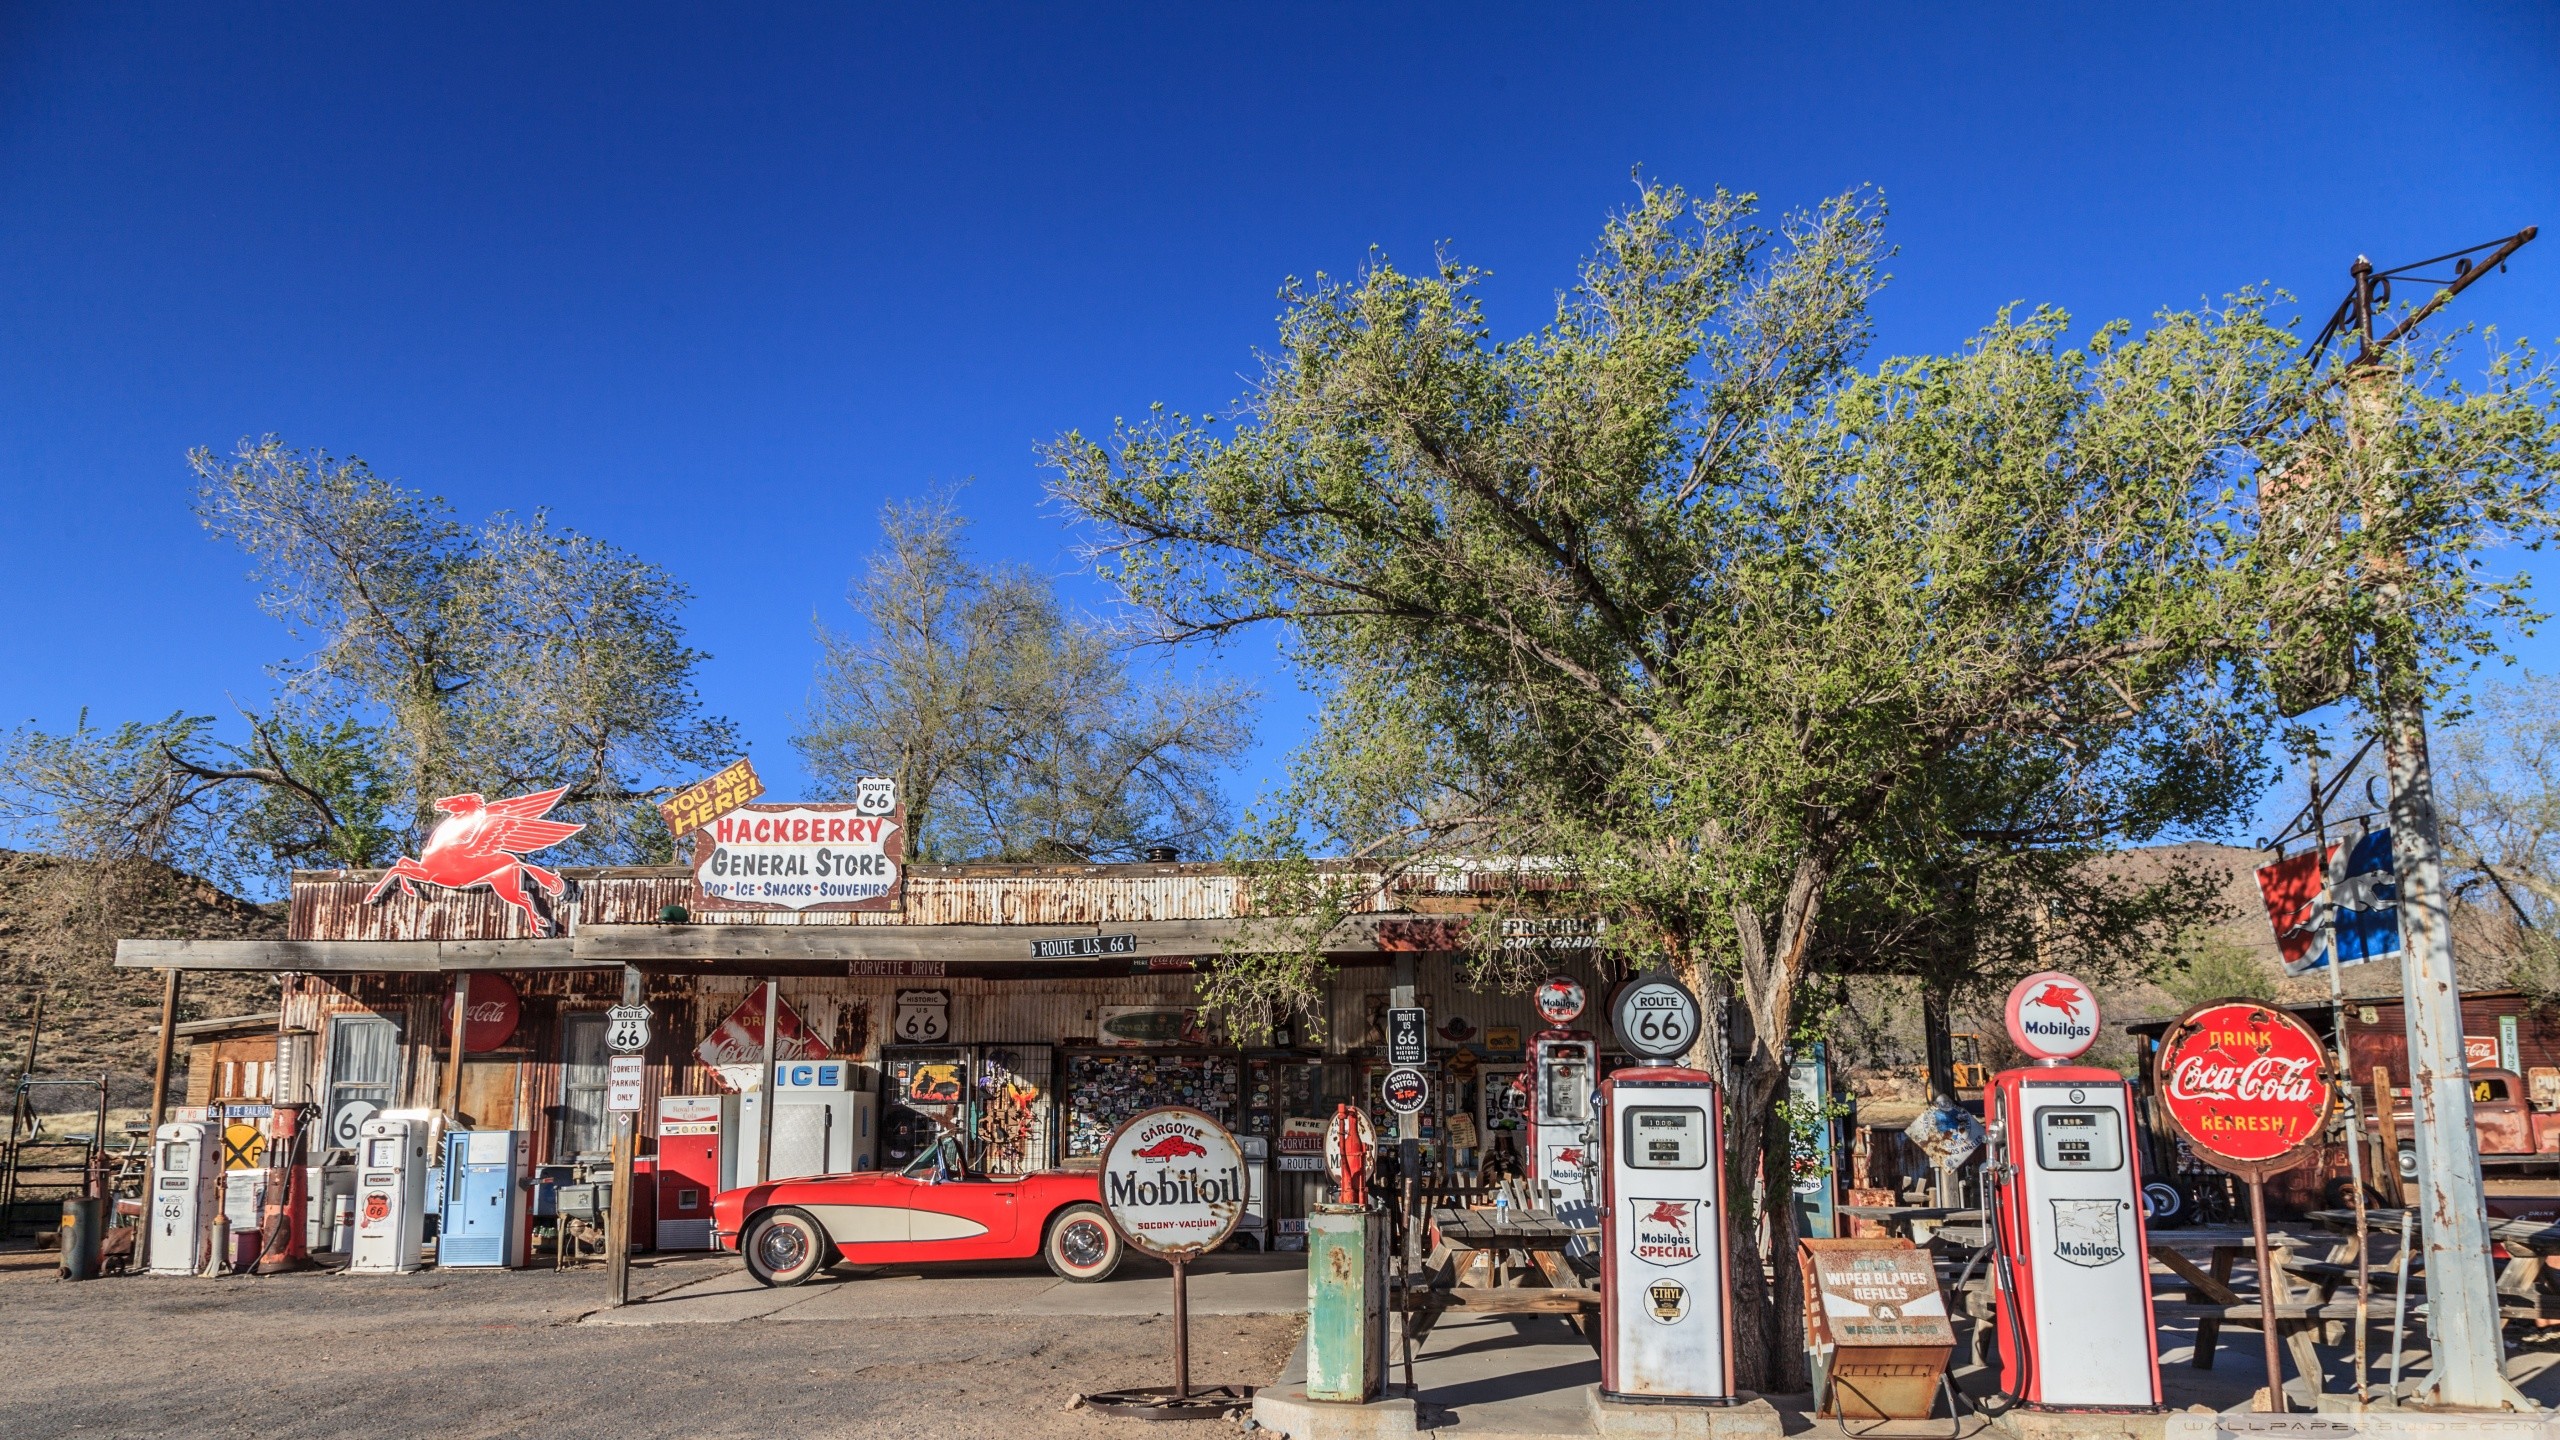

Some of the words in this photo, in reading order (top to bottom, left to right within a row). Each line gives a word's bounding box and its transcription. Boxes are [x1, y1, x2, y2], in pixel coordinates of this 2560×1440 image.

[666, 788, 708, 816] YOU
[716, 763, 750, 791] ARE
[862, 783, 891, 791] ROUTE
[675, 776, 758, 836] HERE!
[863, 793, 889, 809] 66
[717, 816, 884, 844] HACKBERRY
[1041, 939, 1076, 957] ROUTE
[1083, 938, 1104, 954] U.S.
[1111, 937, 1125, 952] 66
[853, 961, 902, 976] CORVETTE
[912, 961, 941, 976] DRIVE
[1543, 998, 1580, 1009] Mobilgas
[1640, 997, 1678, 1007] ROUTE
[617, 1010, 642, 1019] ROUTE
[1397, 1013, 1416, 1021] ROUTE
[743, 1016, 783, 1027] DRIK
[906, 1015, 937, 1035] 66
[1403, 1021, 1411, 1029] US
[1640, 1011, 1681, 1041] 66
[2025, 1021, 2091, 1039] Mobilgas
[616, 1030, 640, 1046] 66
[1397, 1030, 1418, 1045] 66
[2210, 1031, 2272, 1046] DRINK
[613, 1066, 640, 1074] CORVETTE
[777, 1065, 839, 1087] ICE
[612, 1079, 640, 1088] PARKING
[1391, 1073, 1416, 1083] ROYAL
[2170, 1056, 2317, 1102] Coca-Cola
[1390, 1080, 1418, 1091] TRITON
[1390, 1098, 1411, 1110] MOTOR
[233, 1107, 241, 1116] FE
[1295, 1120, 1320, 1128] WE'RE
[1140, 1122, 1200, 1143] GARGOYLE
[1282, 1138, 1322, 1149] CORVETTE
[1287, 1158, 1312, 1169] ROUTE
[1552, 1169, 1583, 1180] Mobilga
[1108, 1165, 1242, 1207] Mobiloil
[164, 1205, 181, 1218] 66
[370, 1206, 383, 1216] 66
[1137, 1220, 1218, 1230] SOCONY-VACUUM
[1284, 1221, 1308, 1232] MOBIL
[1641, 1233, 1690, 1246] Mobilgas
[1640, 1246, 1694, 1258] SPECIAL
[2060, 1241, 2120, 1260] Mobilgas
[1853, 1260, 1897, 1272] ATLAS
[1825, 1272, 1872, 1285] WIPER
[1874, 1272, 1927, 1285] BLADES
[1653, 1288, 1681, 1299] ETHYL
[1853, 1287, 1908, 1300] REFILLS
[1844, 1325, 1900, 1335] WASHER
